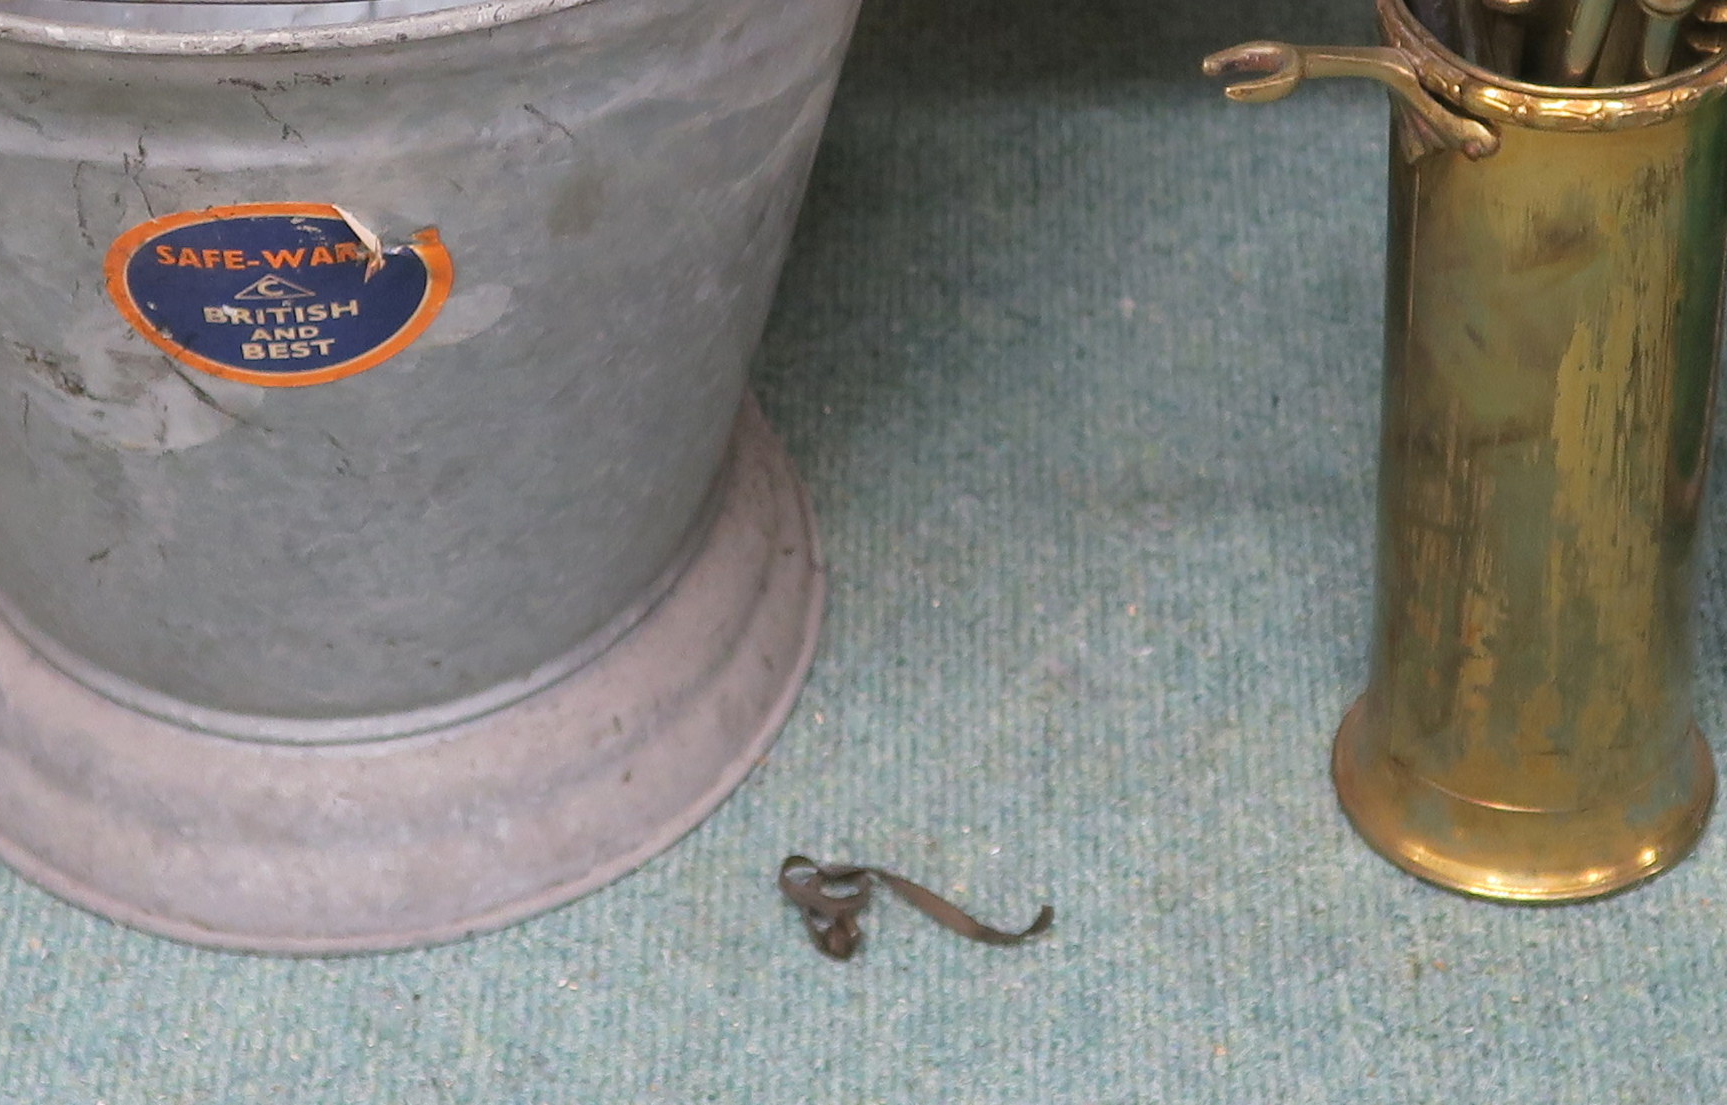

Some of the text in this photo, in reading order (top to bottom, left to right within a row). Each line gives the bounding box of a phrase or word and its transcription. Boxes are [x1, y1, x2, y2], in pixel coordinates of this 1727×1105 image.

[203, 300, 359, 325] BRITISH
[250, 326, 320, 341] AND
[241, 339, 336, 360] BEST
